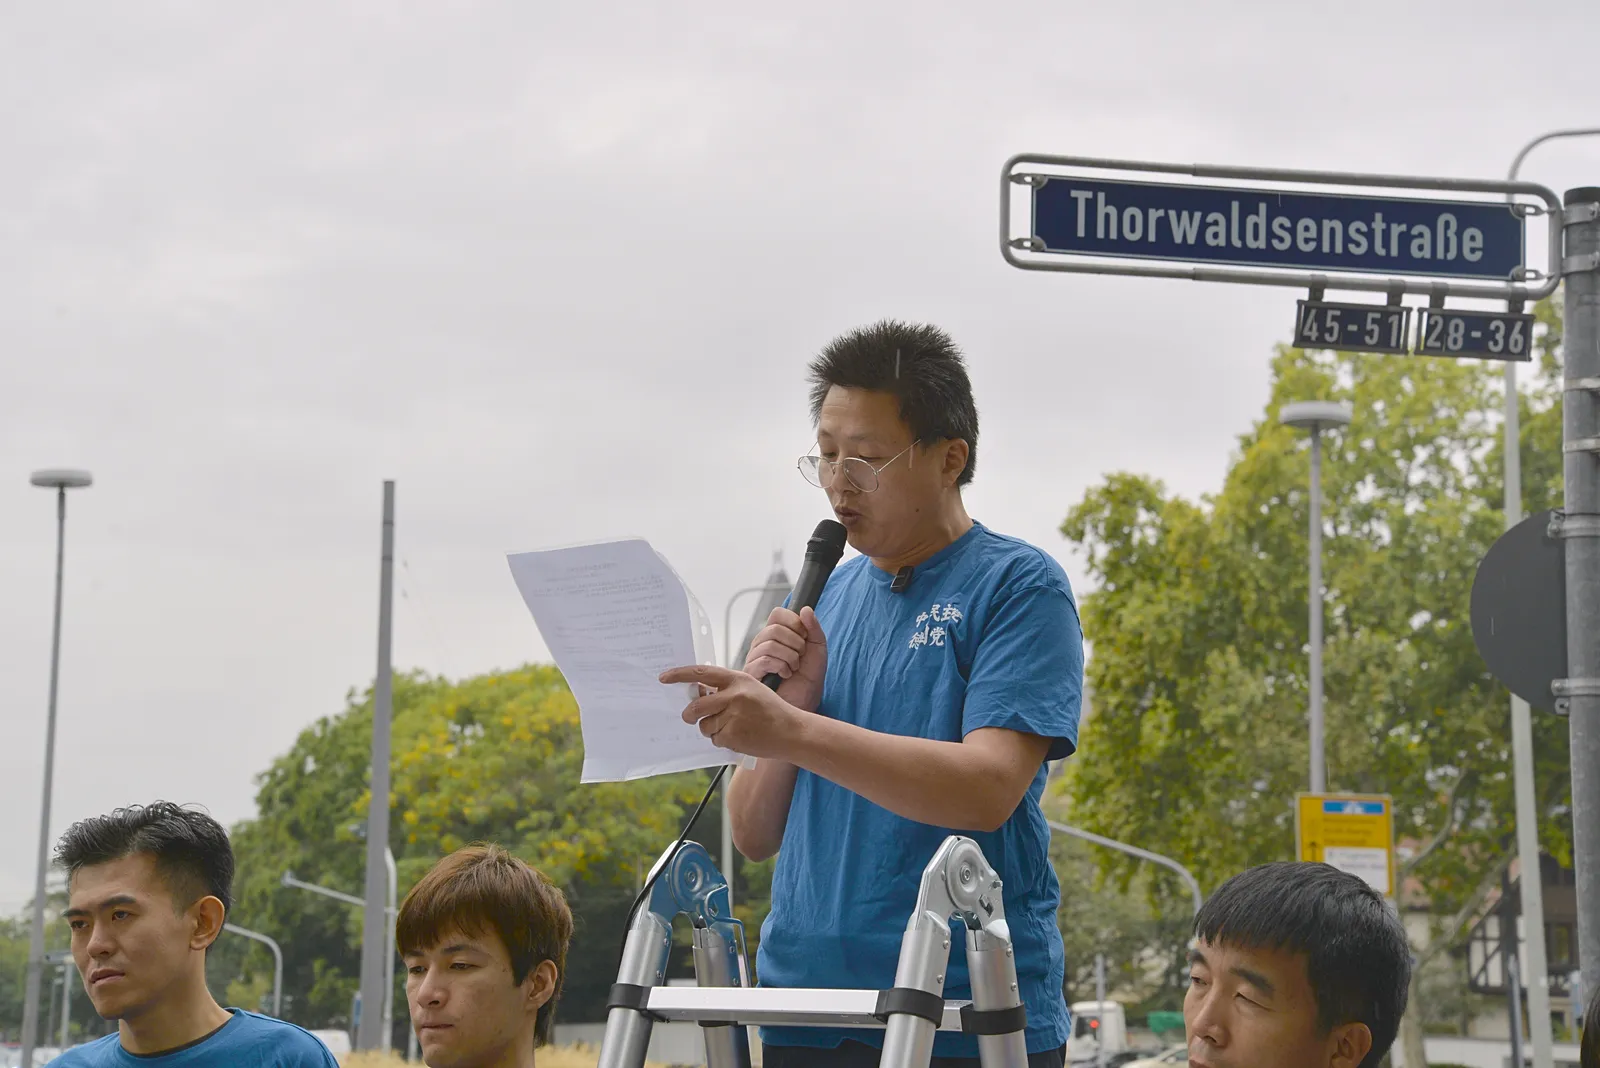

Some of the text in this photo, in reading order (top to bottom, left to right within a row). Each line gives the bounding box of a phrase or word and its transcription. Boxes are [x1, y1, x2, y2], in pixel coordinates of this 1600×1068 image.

[1070, 190, 1484, 262] Thorwaldsenstraße
[1302, 308, 1400, 348] 45-51
[1426, 315, 1524, 354] 28-36
